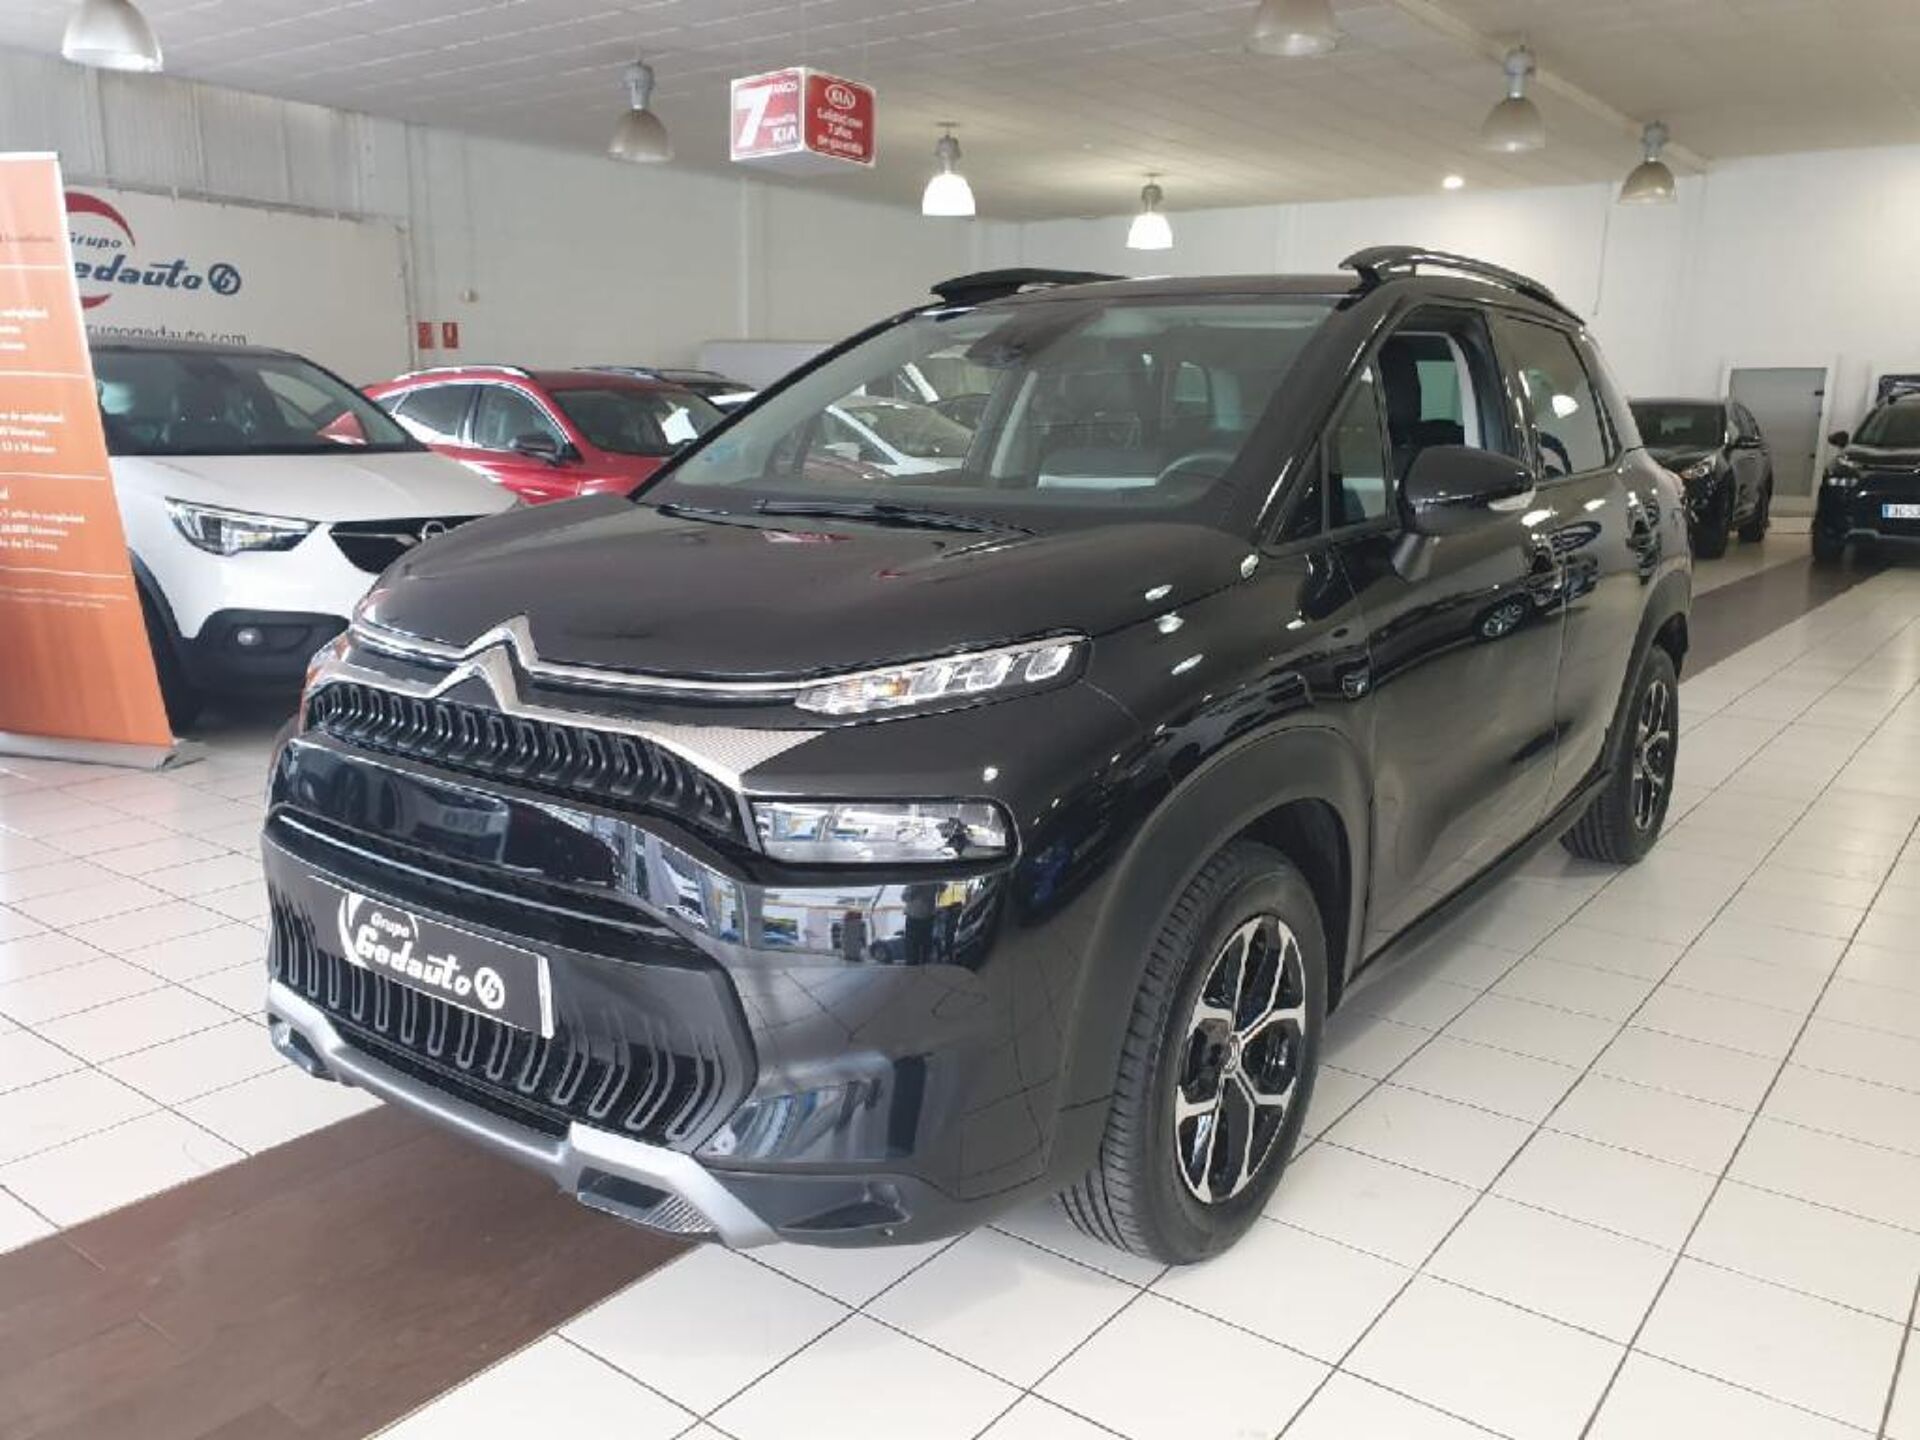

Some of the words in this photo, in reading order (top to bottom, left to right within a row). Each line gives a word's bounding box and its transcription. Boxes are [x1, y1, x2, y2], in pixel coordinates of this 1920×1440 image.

[734, 84, 773, 149] 7
[772, 125, 798, 143] KIA
[75, 254, 202, 290] edauto
[371, 912, 410, 938] Grupo
